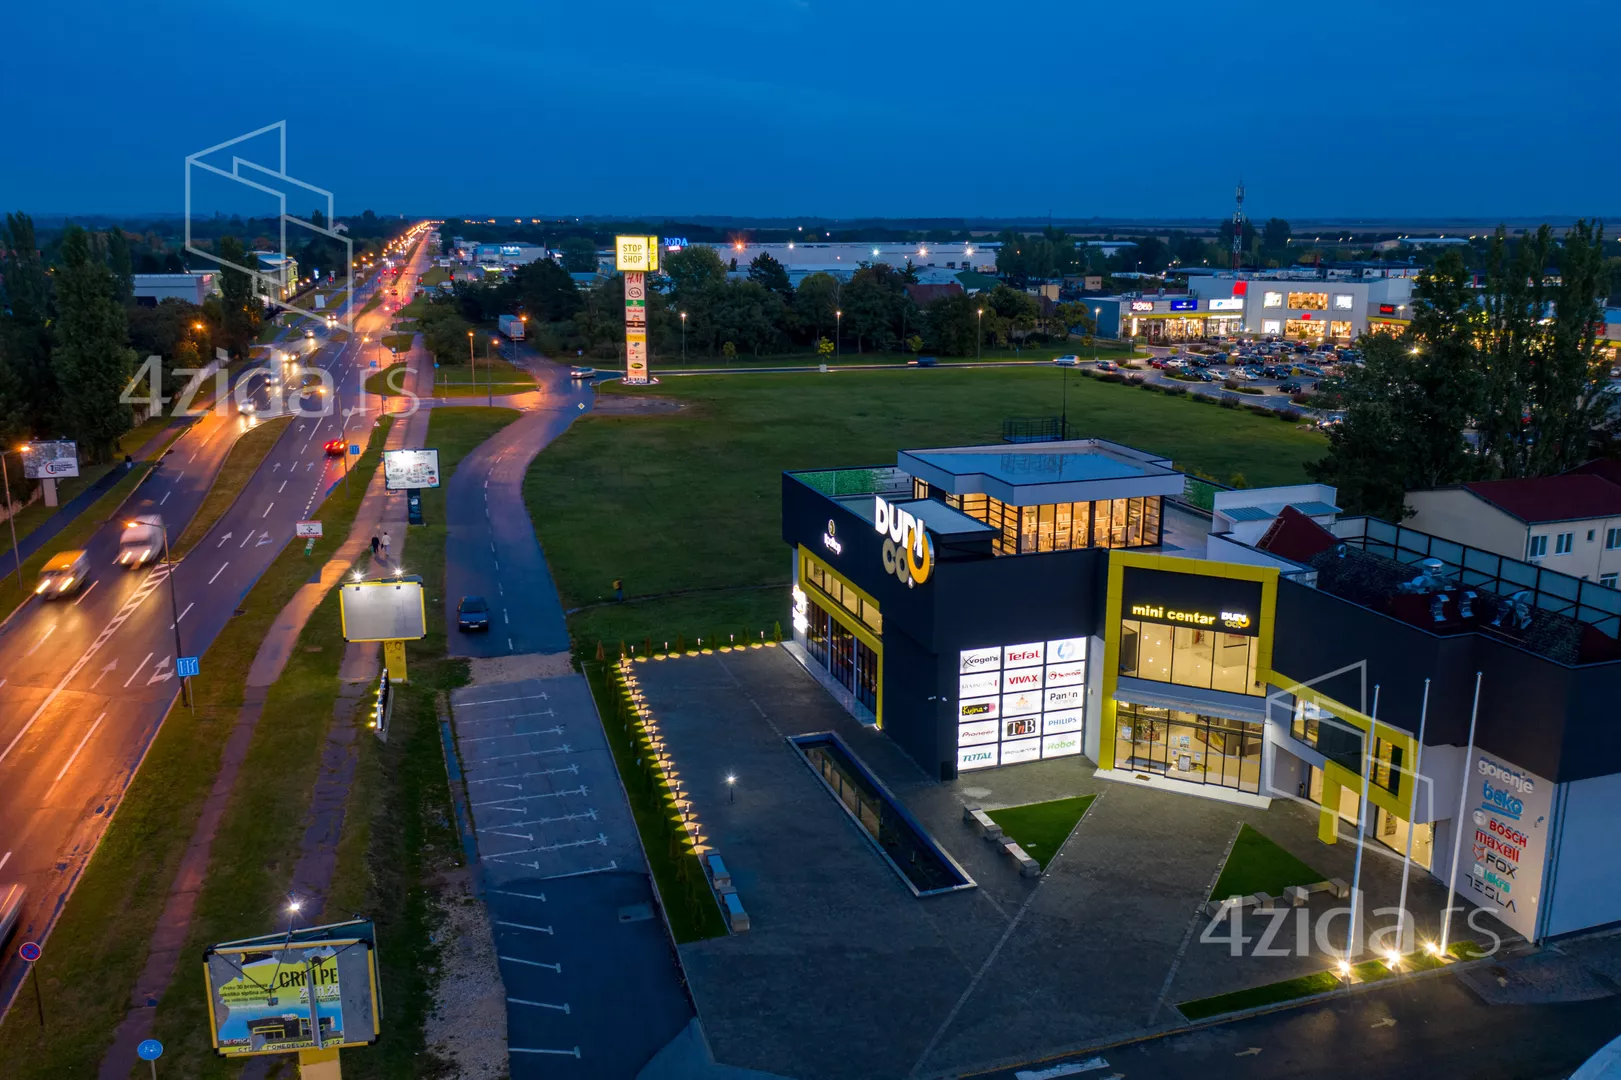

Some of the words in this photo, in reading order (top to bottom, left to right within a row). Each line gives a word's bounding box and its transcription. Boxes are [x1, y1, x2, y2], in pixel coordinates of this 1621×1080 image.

[623, 244, 642, 252] STOP
[623, 255, 642, 263] SHOP
[1132, 605, 1163, 618] mini
[1166, 610, 1216, 625] centar
[1007, 650, 1040, 661] Tefal
[1008, 674, 1038, 685] VIVAX
[1048, 717, 1077, 726] PHILIPS
[961, 730, 994, 738] Pioneer
[1478, 759, 1534, 794] gorenje
[1482, 782, 1523, 815] beko
[1489, 819, 1527, 848] BOSCH
[1475, 830, 1520, 863] maxell
[1486, 853, 1516, 879] FOX
[1465, 873, 1516, 913] TESLA
